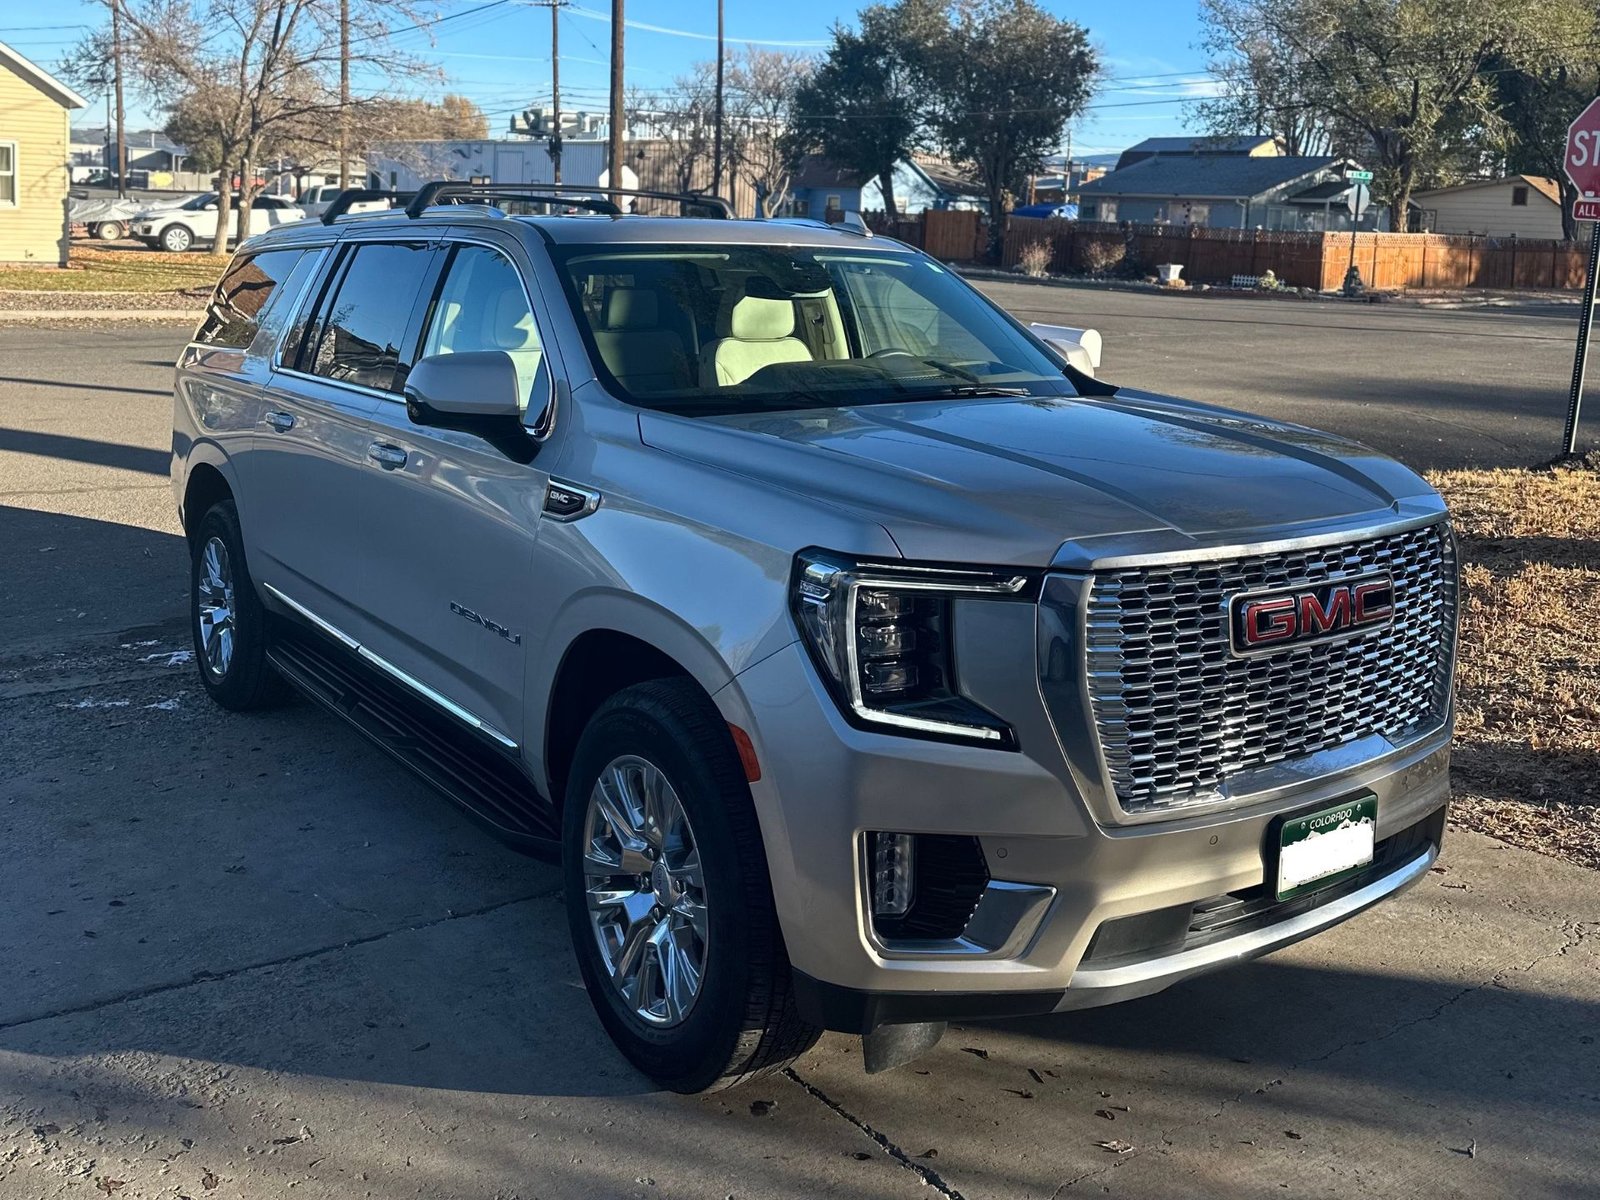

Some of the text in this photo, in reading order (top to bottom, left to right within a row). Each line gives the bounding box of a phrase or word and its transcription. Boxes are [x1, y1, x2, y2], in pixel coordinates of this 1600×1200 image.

[1577, 204, 1597, 217] ALL
[550, 490, 569, 504] GMC
[1244, 579, 1392, 646] GMC
[450, 601, 521, 647] DENALI
[1309, 808, 1352, 830] COLORADO
